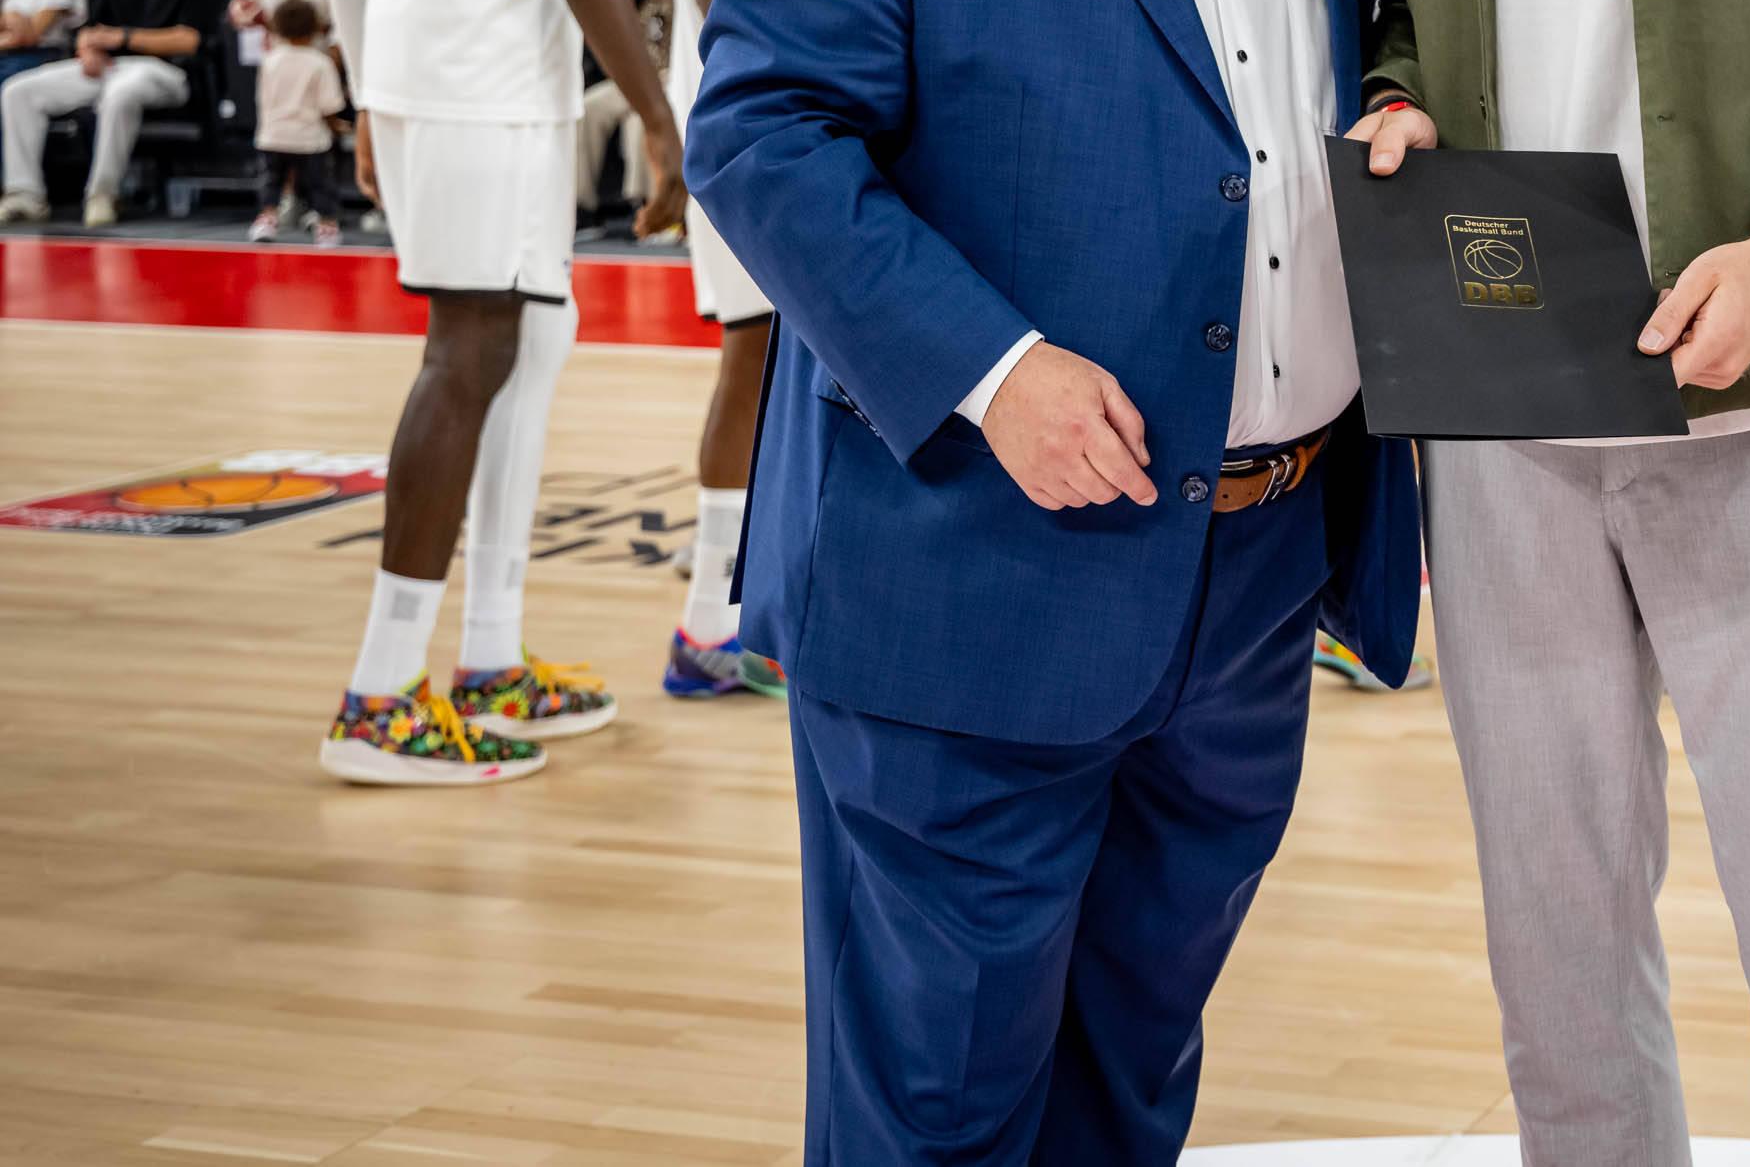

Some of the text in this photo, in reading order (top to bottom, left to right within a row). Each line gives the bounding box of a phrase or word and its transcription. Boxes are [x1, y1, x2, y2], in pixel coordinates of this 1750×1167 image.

[1464, 219, 1509, 229] Deutscher
[1452, 225, 1524, 236] Basketball Bund
[1463, 281, 1538, 305] DBB
